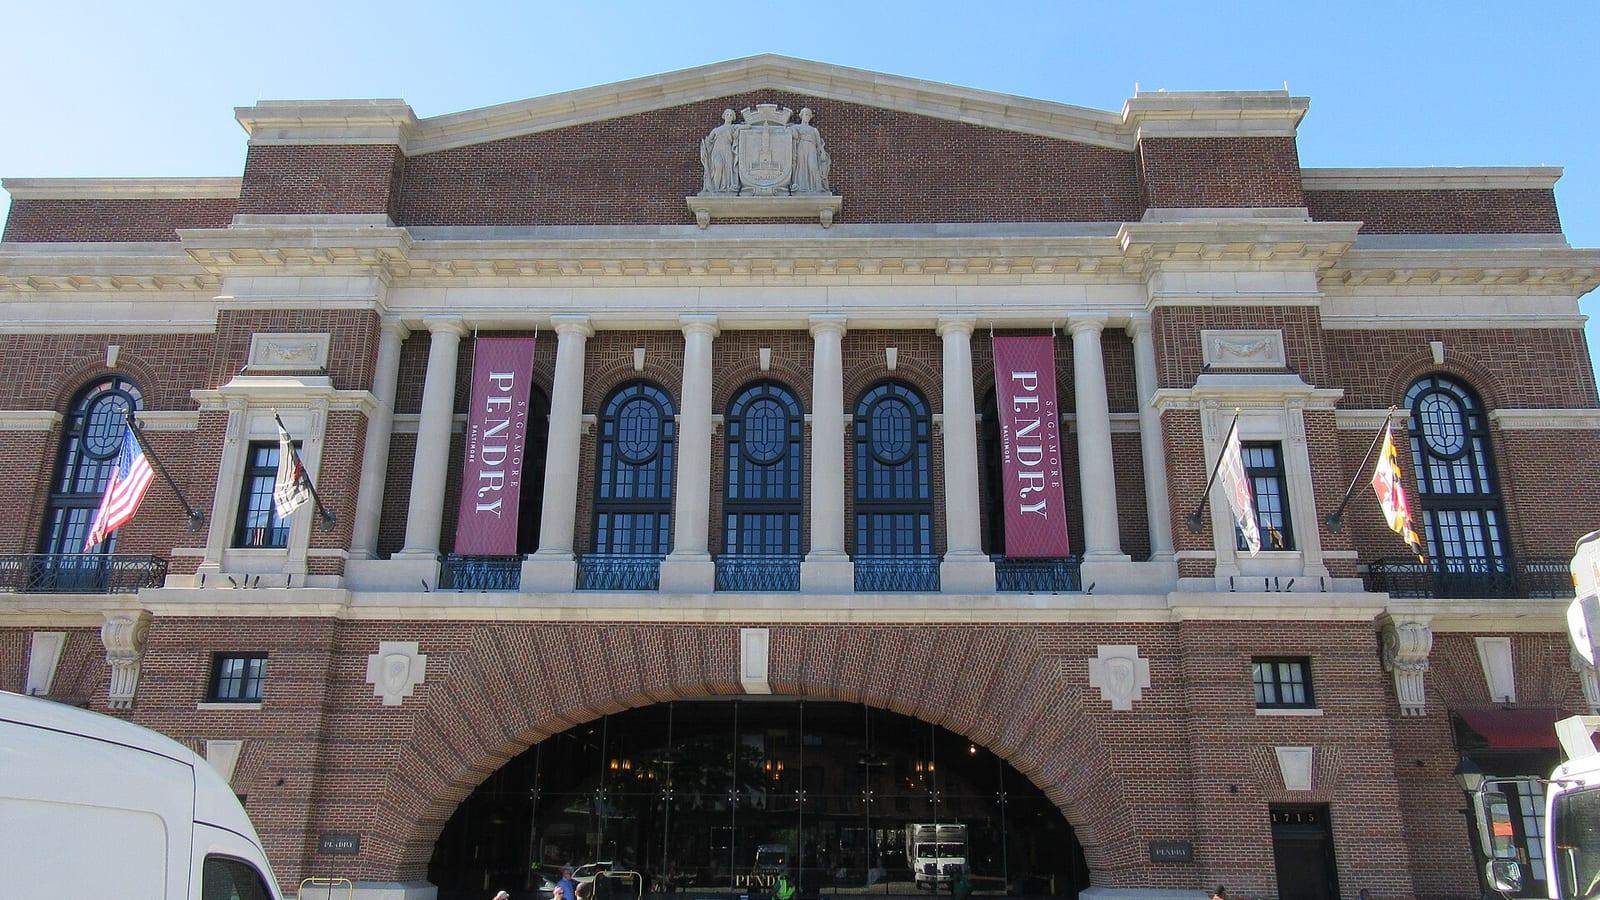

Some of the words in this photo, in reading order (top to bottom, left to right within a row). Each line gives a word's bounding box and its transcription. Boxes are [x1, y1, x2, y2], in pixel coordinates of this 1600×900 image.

[469, 424, 479, 463] BALTIMORE
[475, 371, 515, 519] PENDRY
[510, 400, 526, 489] SAGAMORE
[1002, 424, 1011, 464] BALTIMORE
[1011, 370, 1048, 520] PENDRY
[1045, 400, 1060, 488] SAGAMORE
[1272, 813, 1315, 823] 1715
